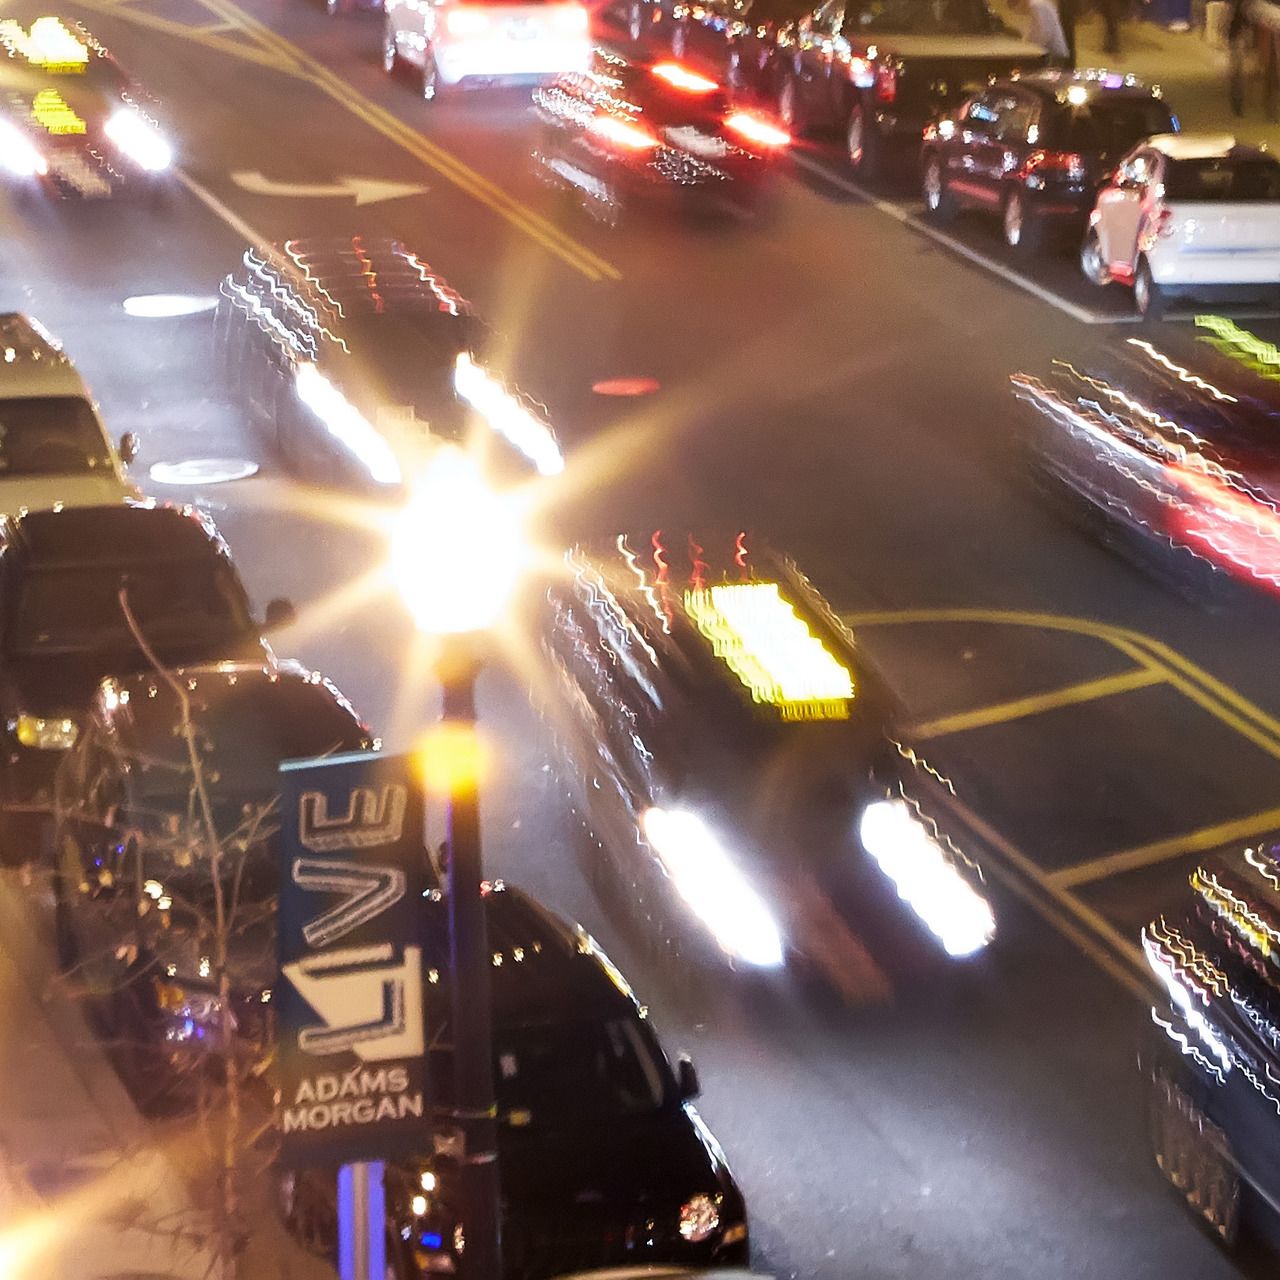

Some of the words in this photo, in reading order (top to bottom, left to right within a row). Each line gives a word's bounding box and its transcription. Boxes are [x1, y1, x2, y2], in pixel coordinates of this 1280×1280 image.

[292, 783, 408, 1056] LIVE
[295, 1065, 409, 1106] ADAMS
[283, 1092, 425, 1134] MORGAN
